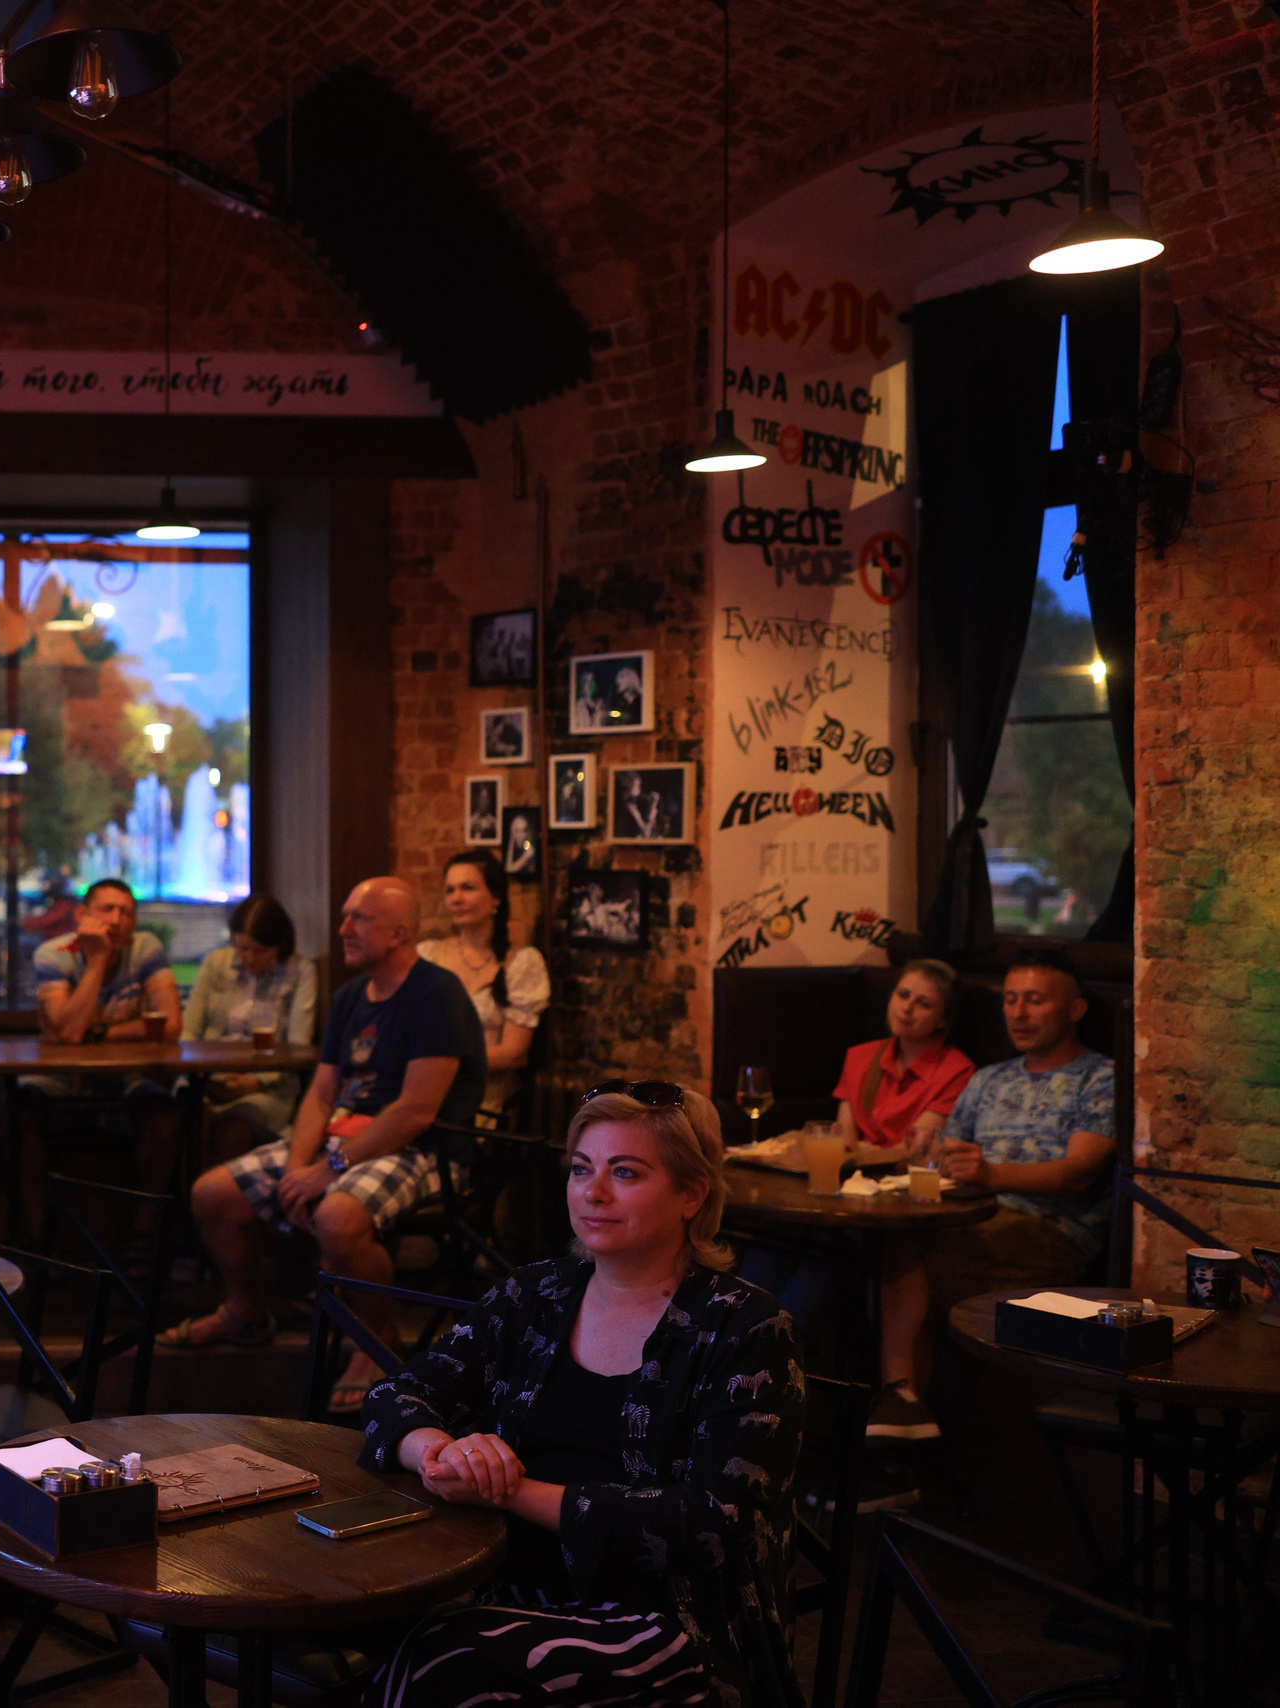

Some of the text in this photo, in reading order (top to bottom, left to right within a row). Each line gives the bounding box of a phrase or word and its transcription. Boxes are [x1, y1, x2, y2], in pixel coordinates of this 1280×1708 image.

[917, 150, 1056, 204] КИНО
[120, 355, 227, 396] чтобы
[241, 368, 349, 406] ждать
[723, 365, 881, 416] PAPA ROACH
[752, 418, 905, 490] THE OFFSPRING
[773, 547, 854, 588] MODE
[723, 606, 895, 659] EVANESCENCE
[813, 710, 895, 777] DIO
[719, 785, 896, 832] HELLOWEEN
